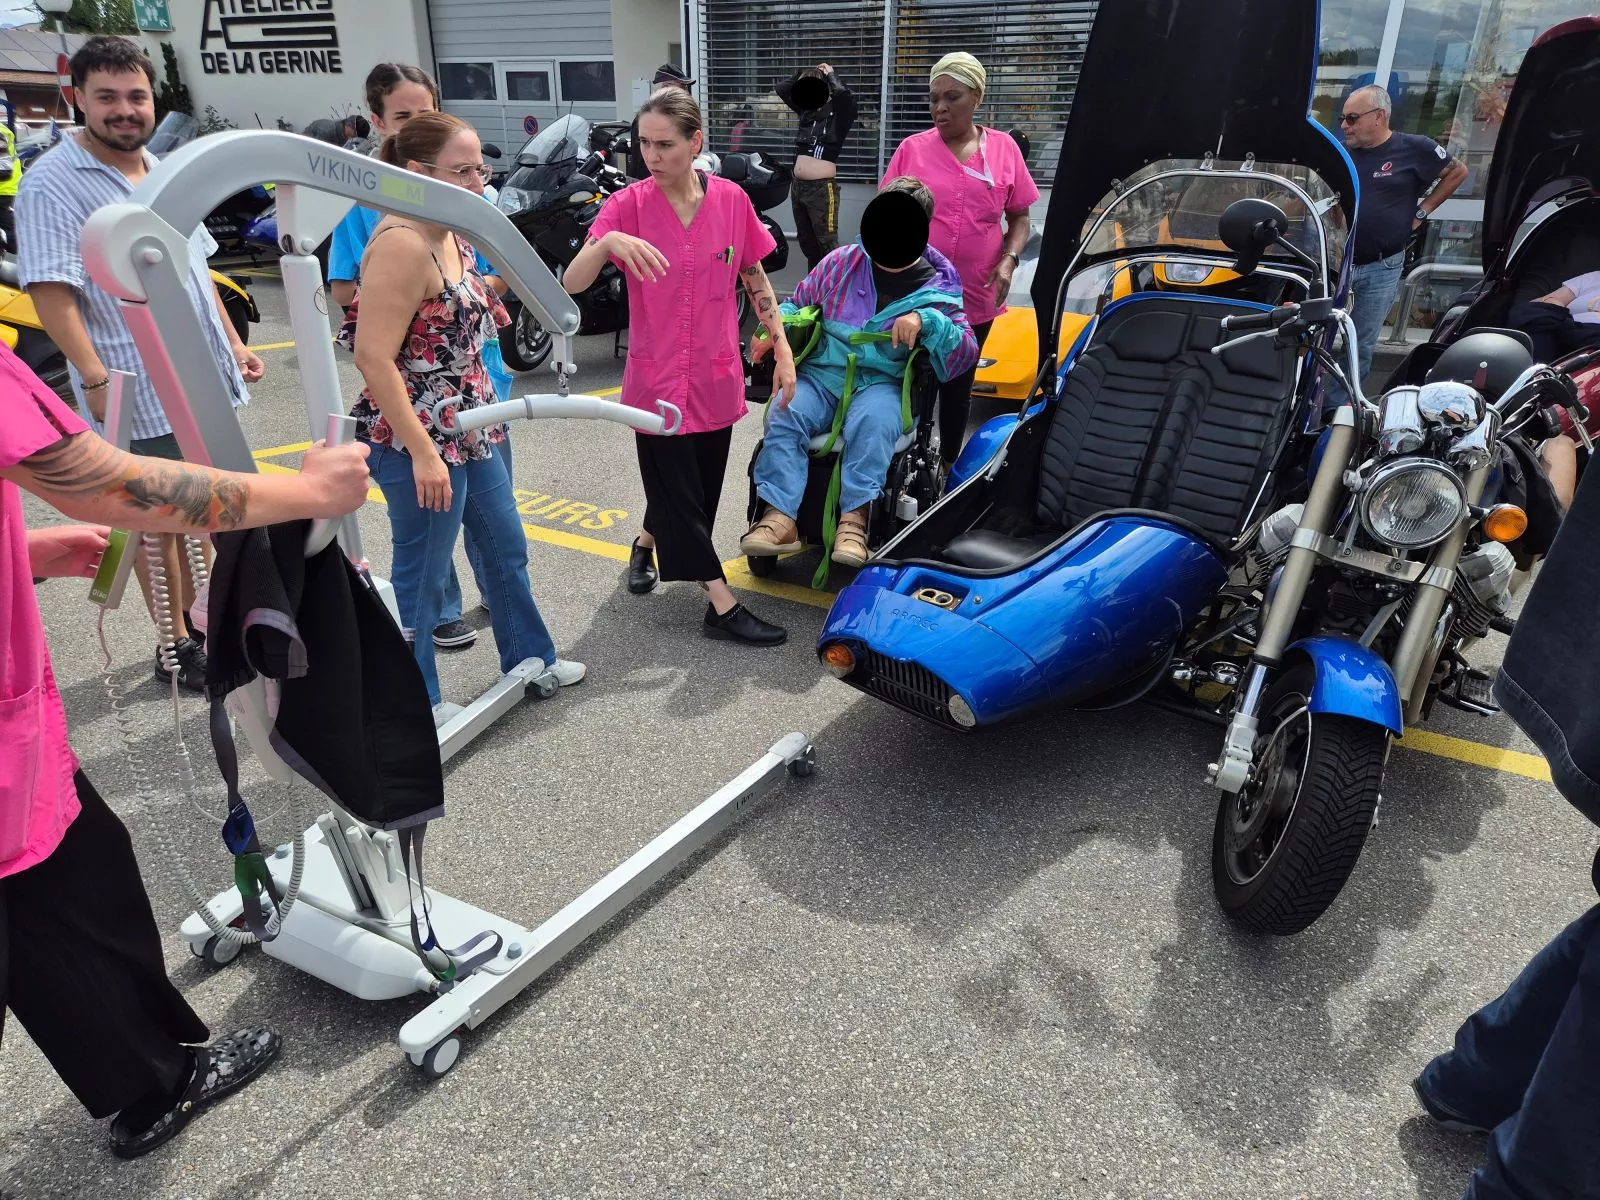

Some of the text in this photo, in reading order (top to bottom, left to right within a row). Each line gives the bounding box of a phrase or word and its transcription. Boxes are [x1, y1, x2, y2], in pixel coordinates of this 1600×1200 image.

[201, 50, 343, 74] DE LA GERINE
[308, 152, 377, 190] VIKING
